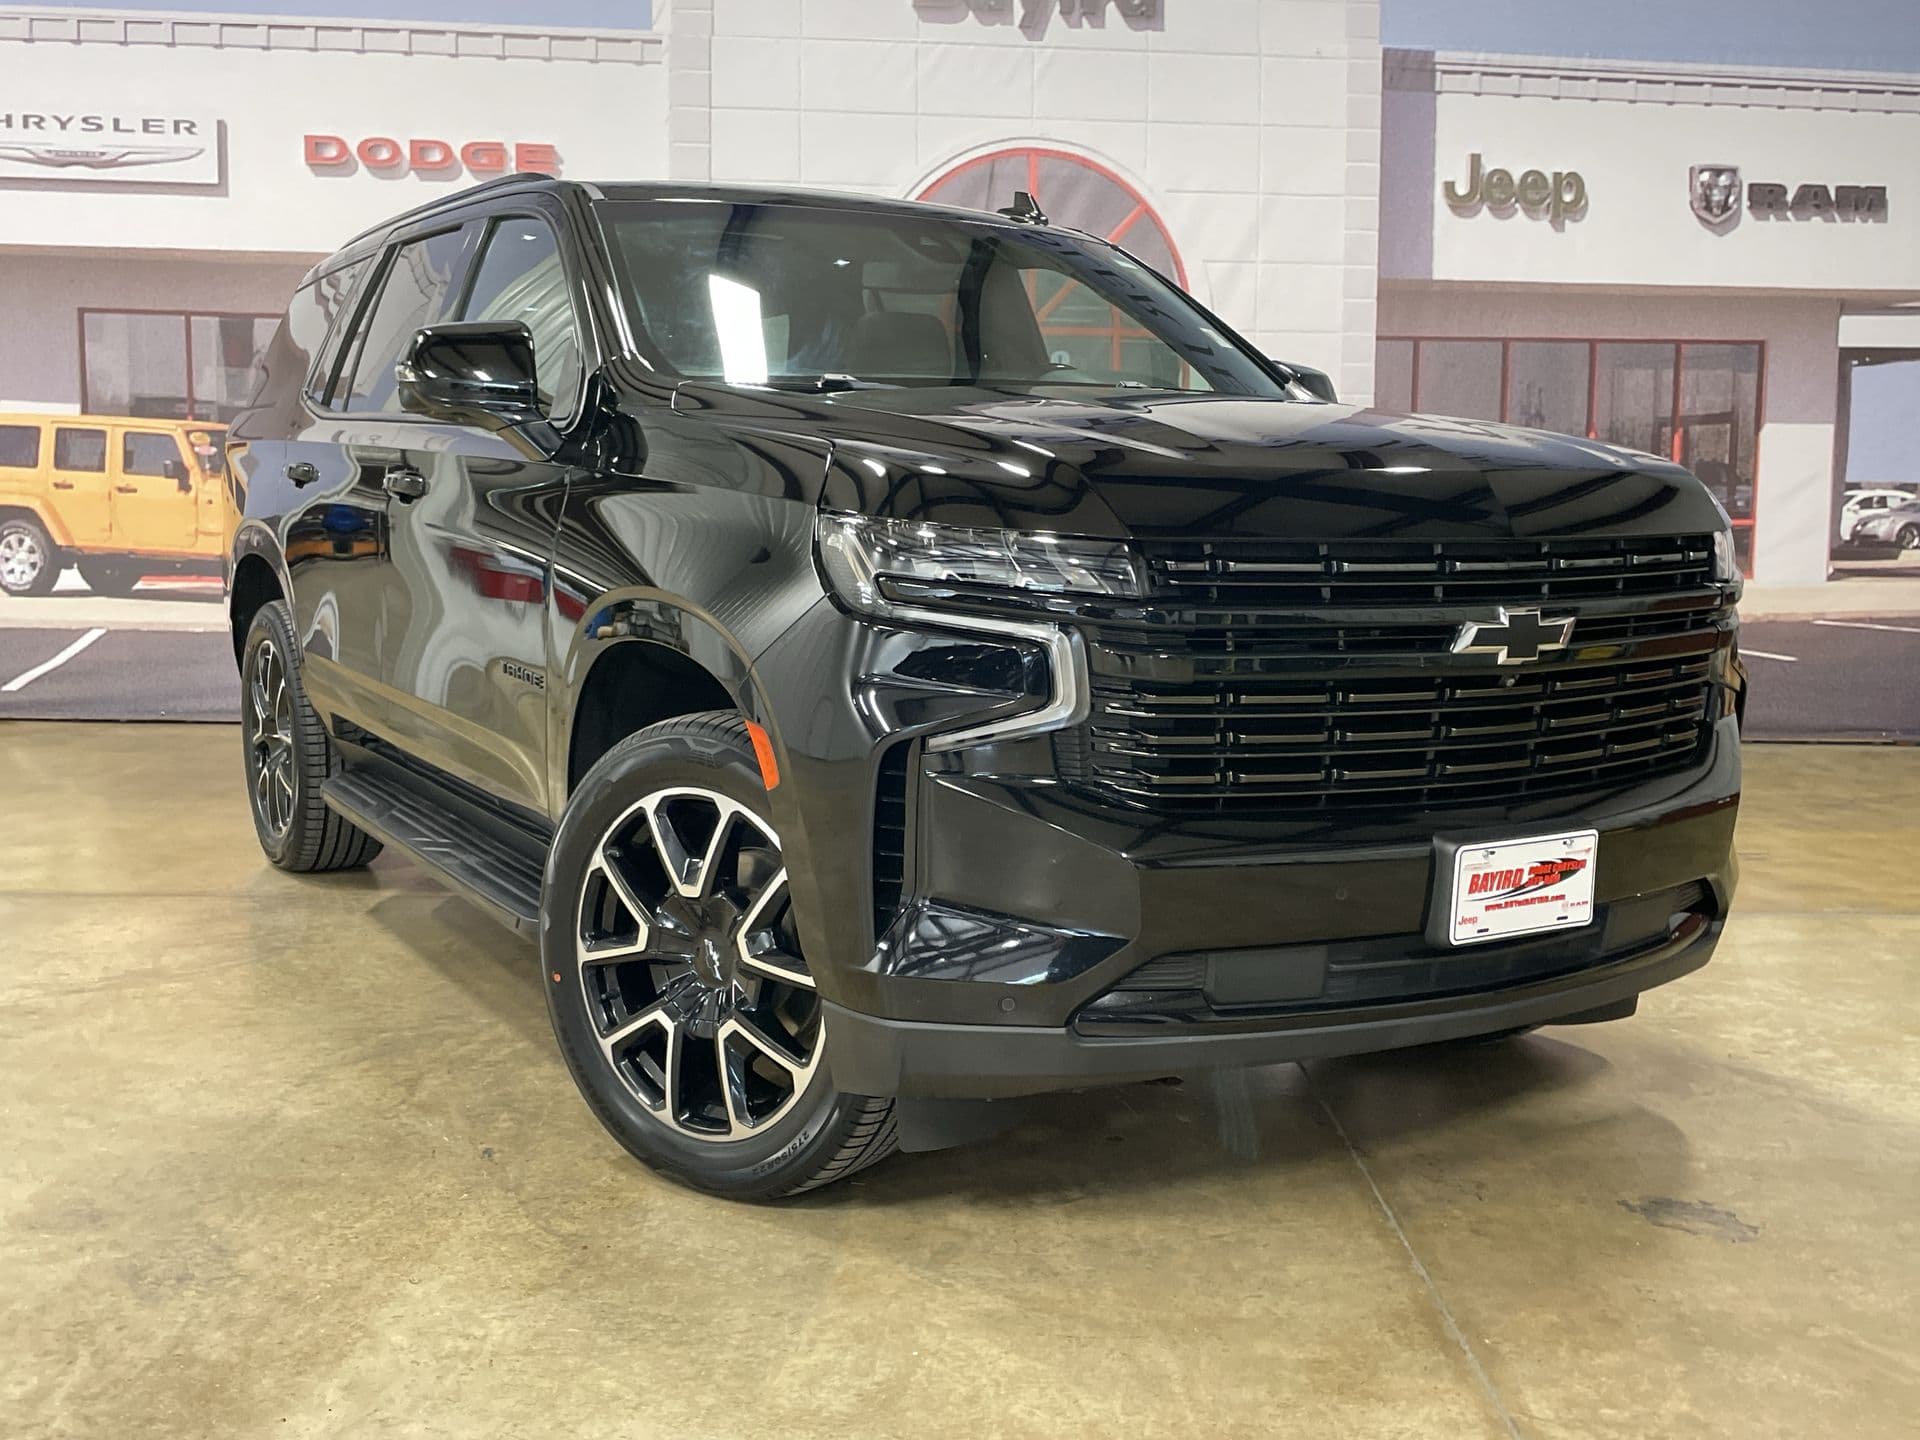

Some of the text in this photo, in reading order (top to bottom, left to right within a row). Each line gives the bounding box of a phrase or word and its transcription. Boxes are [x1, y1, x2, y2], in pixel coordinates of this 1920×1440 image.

[303, 134, 560, 176] DODGE
[1443, 153, 1588, 228] Jeep
[1748, 183, 1888, 220] RAM
[1468, 868, 1524, 894] BAYIRD
[1458, 915, 1478, 926] Jeep
